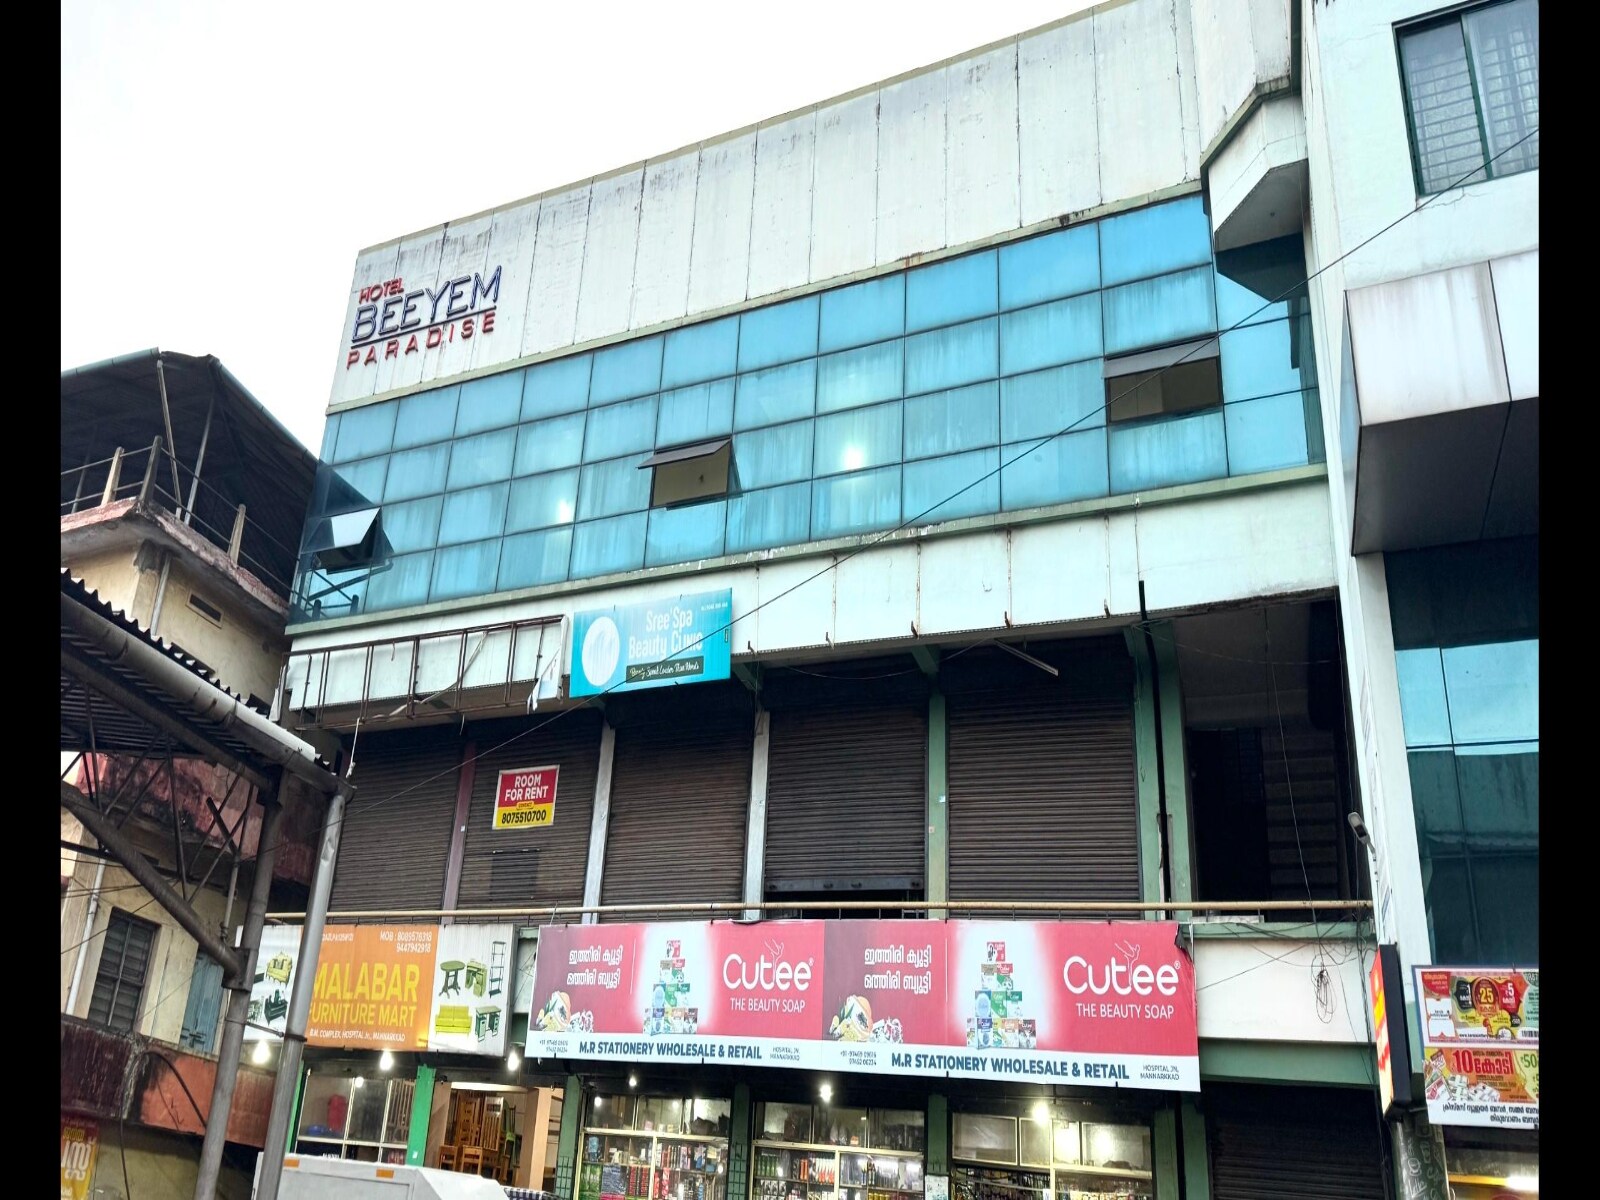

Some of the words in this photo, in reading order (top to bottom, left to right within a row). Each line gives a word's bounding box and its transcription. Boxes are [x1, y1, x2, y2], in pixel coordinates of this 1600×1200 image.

[359, 278, 404, 304] HOTEL
[352, 265, 502, 343] BEEYEM
[347, 311, 496, 370] PARADISE
[629, 635, 667, 659] Beauty
[514, 773, 542, 788] ROOM
[505, 789, 523, 801] FOR
[525, 786, 548, 800] RENT
[502, 809, 547, 824] 8075510700
[864, 944, 904, 965] ഇത്തിരി
[723, 953, 813, 991] Cutee
[1063, 955, 1180, 997] Cutee
[730, 997, 746, 1011] THE
[747, 998, 781, 1012] BEAUTY
[782, 998, 806, 1013] SOAP
[1479, 988, 1495, 1003] 25
[378, 1005, 417, 1028] MART
[1076, 1002, 1097, 1017] THE
[1100, 1003, 1143, 1018] BEAUTY
[1145, 1004, 1175, 1019] SOAP
[341, 1030, 363, 1039] HOSPITAL
[579, 1041, 596, 1054] M.R
[597, 1041, 654, 1056] STATIONERY
[656, 1043, 716, 1058] WHOLESALE
[718, 1045, 725, 1058] &
[727, 1045, 763, 1059] RETAIL
[892, 1053, 912, 1068] M.R
[915, 1054, 987, 1072] STATIONERY
[991, 1056, 1069, 1077] WHOLESALE
[1072, 1061, 1081, 1077] &
[1084, 1063, 1130, 1080] RETAIL
[1143, 1064, 1169, 1072] HOSPITAL
[1473, 1052, 1514, 1074] കോടി
[1140, 1072, 1180, 1081] MANNARKKAD
